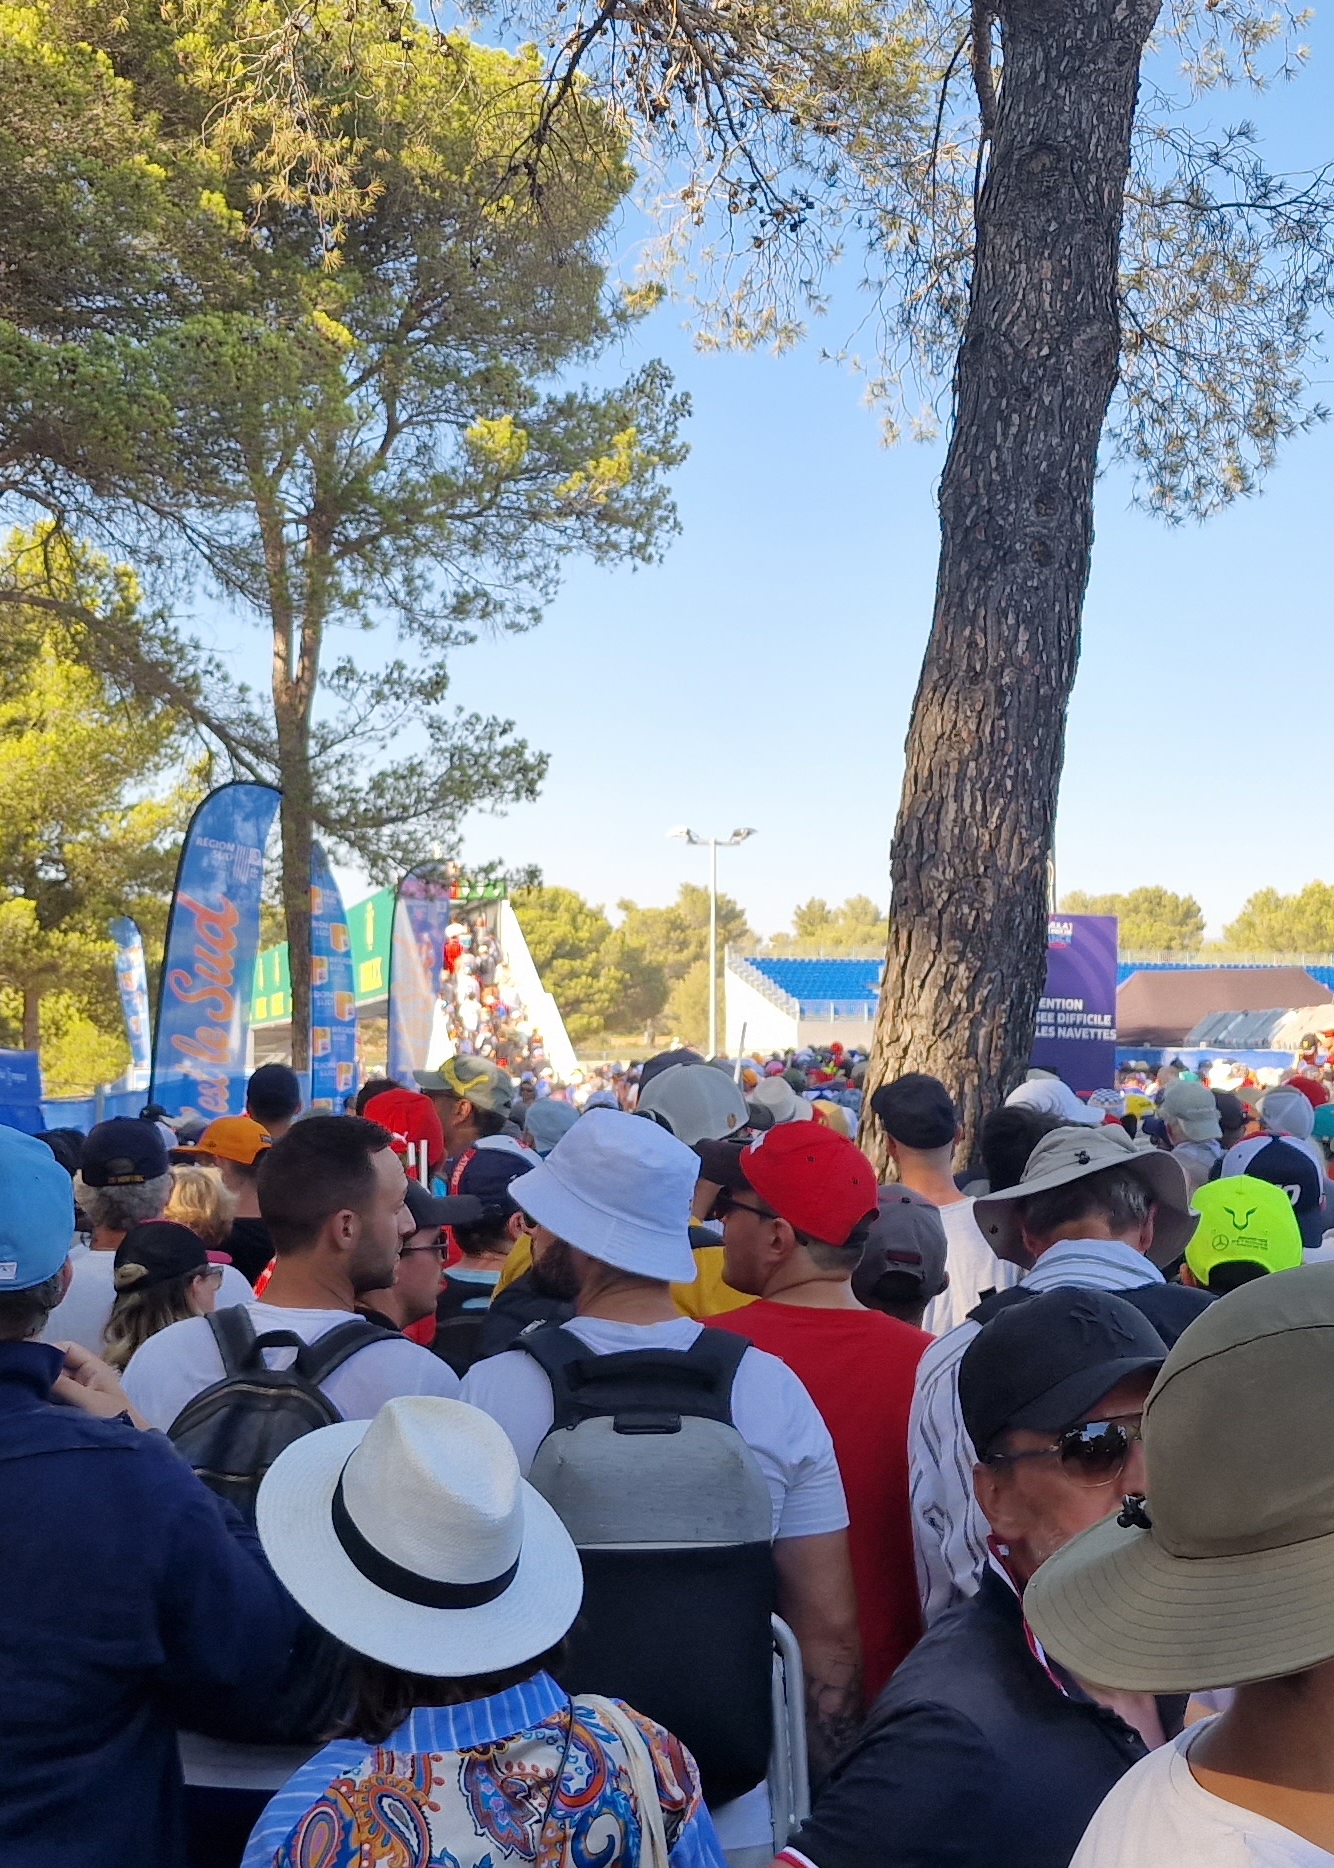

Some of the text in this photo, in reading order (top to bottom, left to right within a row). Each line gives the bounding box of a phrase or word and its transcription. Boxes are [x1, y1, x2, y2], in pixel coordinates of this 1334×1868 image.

[196, 837, 236, 852] RÉGION
[212, 849, 233, 861] SUD
[170, 890, 239, 1022] Sud
[1038, 997, 1084, 1011] ENTION
[1056, 1012, 1112, 1027] DIFFICILE
[1056, 1026, 1117, 1041] NAVETTES
